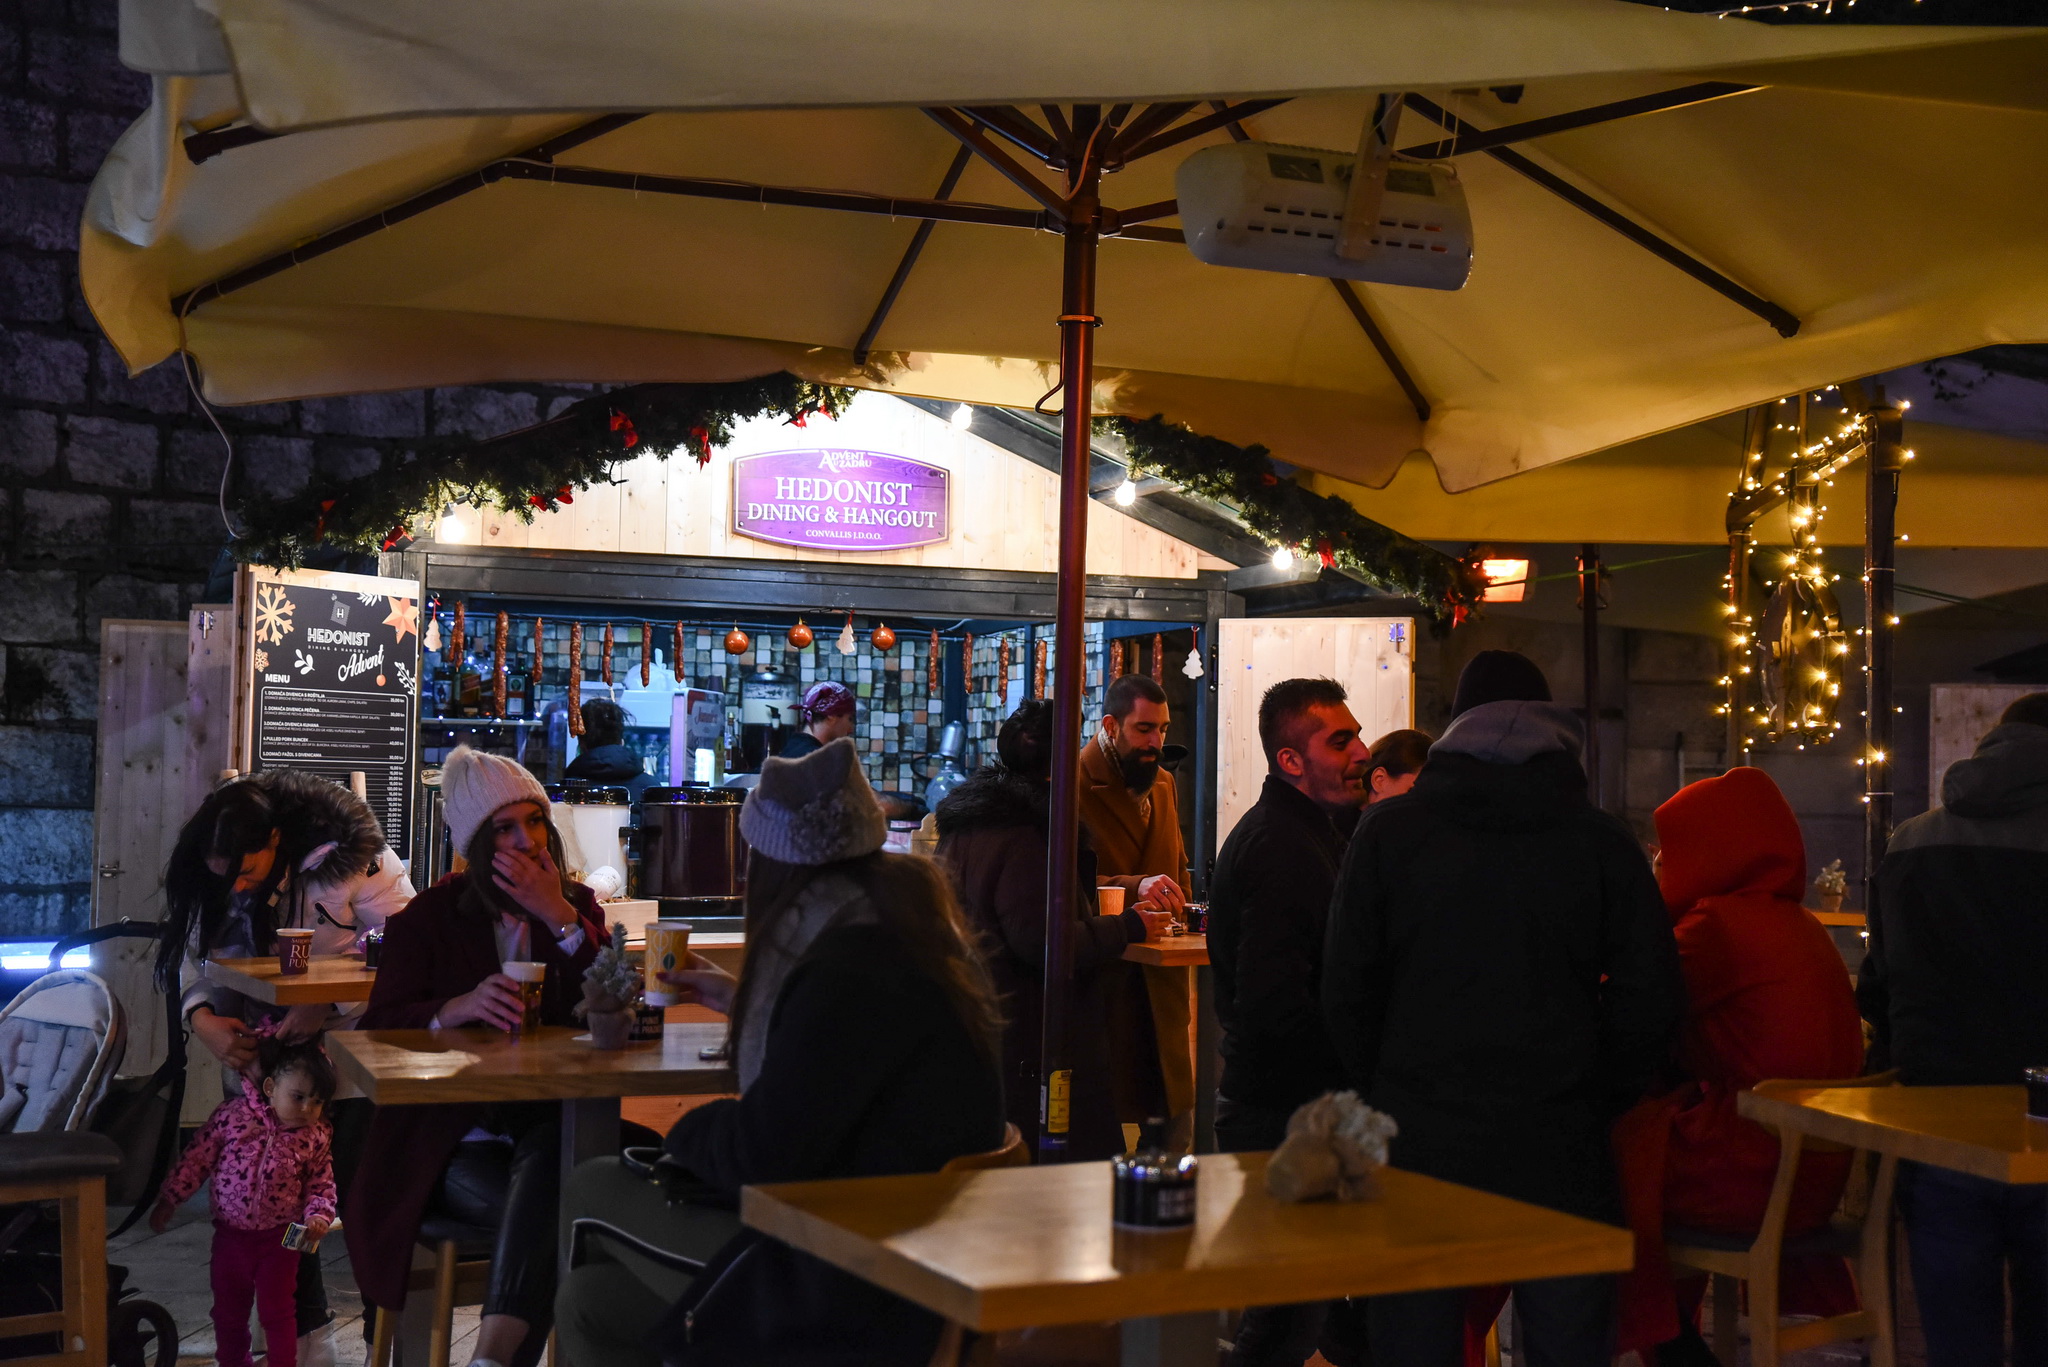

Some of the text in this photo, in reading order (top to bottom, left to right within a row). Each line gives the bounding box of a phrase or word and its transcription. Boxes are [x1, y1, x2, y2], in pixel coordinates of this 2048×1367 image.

[818, 450, 865, 473] ADVENT
[839, 459, 872, 468] ZADRU
[775, 476, 913, 506] HEDONIST
[747, 502, 938, 529] DINING & HANGOUT
[805, 529, 852, 539] CONVALLIS
[336, 608, 344, 618] H
[307, 627, 371, 647] HEDONIST
[338, 643, 384, 682] Advent
[265, 673, 290, 684] MENU
